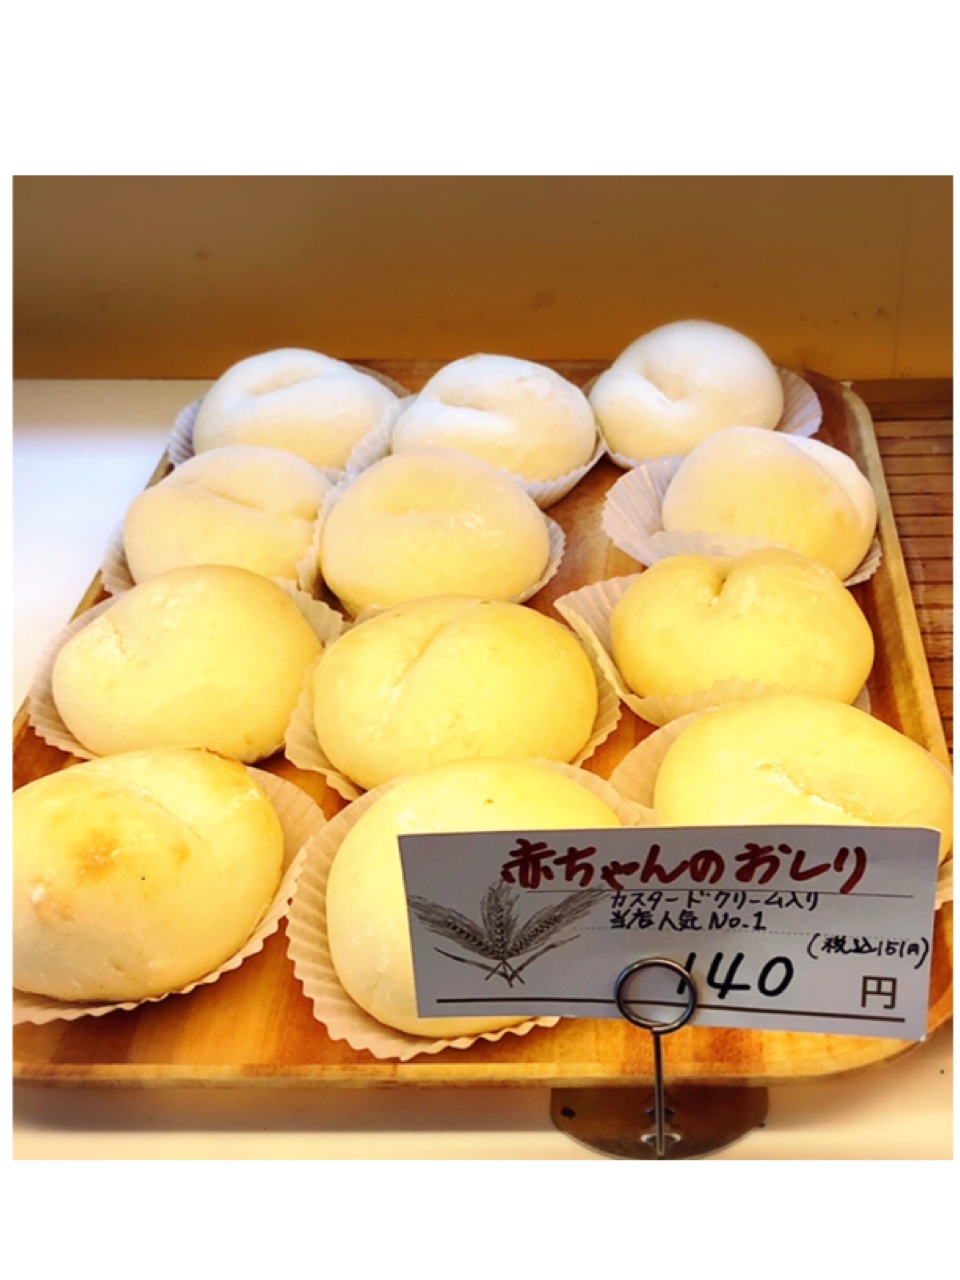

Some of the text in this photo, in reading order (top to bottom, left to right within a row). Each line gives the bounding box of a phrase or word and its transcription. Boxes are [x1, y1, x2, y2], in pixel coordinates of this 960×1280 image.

[501, 838, 868, 894] 赤ちゃんのおしり
[610, 890, 819, 911] カスタードクリーム入り
[676, 951, 898, 1009] 140 円
